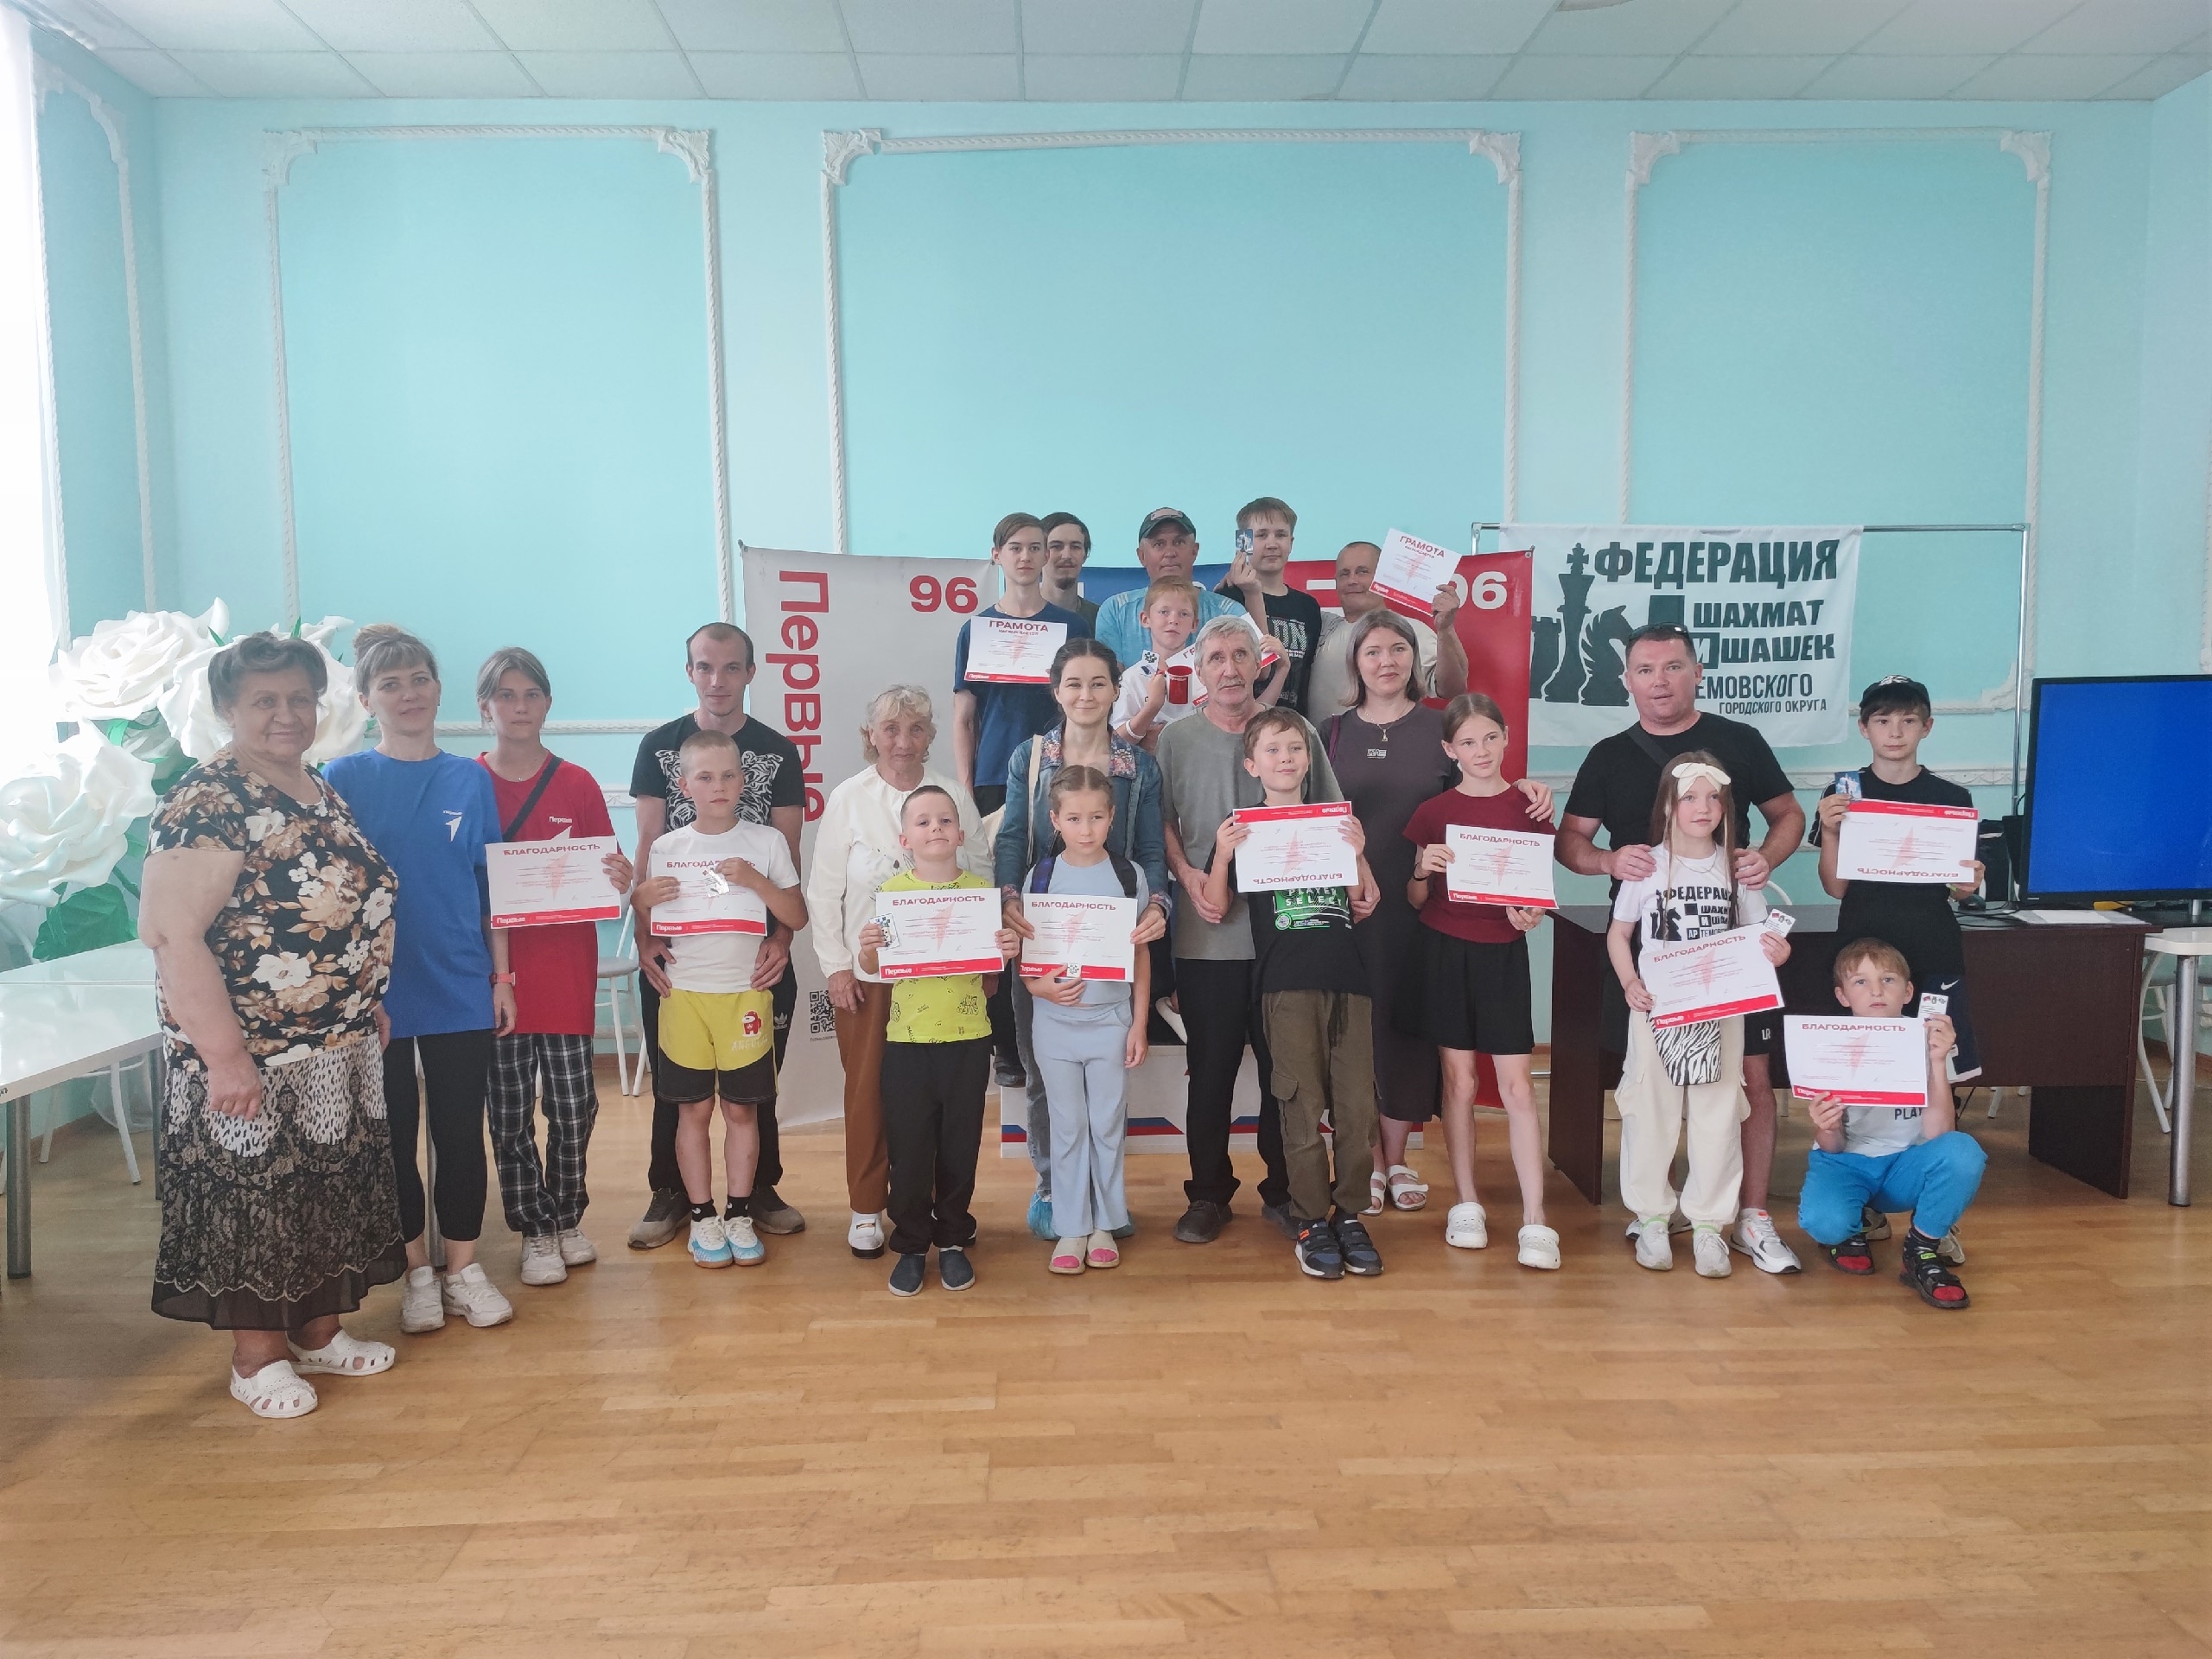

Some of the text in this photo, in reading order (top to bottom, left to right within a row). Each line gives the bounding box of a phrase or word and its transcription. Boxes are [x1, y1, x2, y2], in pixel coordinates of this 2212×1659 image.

[1399, 535, 1446, 558] ГРАМОТА
[1594, 539, 1840, 589] ФЕДЕРАЦИЯ
[909, 575, 979, 613] 96
[1693, 599, 1825, 628] ШАХМАТ
[988, 620, 1049, 632] ГРАМОТА
[1720, 633, 1836, 664] ШАШЕК
[1694, 673, 1813, 700] ЕМОВСКОГО
[1719, 698, 1827, 715] ГОРОДСКОГО ОКРУГА
[1459, 833, 1541, 847] БЛАГОДАРНОСТЬ
[503, 843, 601, 855] БЛАГОДАРНОСТЬ
[666, 860, 756, 868] БЛАГОДАЬ
[1253, 873, 1343, 885] БЛАГОДАРНОСТЬ
[1857, 867, 1960, 878] БЛАГОДАРНОСТЬ
[893, 895, 986, 906] БЛАГОДАРНОСТЬ
[1285, 895, 1342, 906] SELECT
[1662, 886, 1728, 901] ФЕДЕРАЦ
[1031, 901, 1116, 911] БЛАГОДАРНОСТЬ
[1653, 935, 1746, 963] БЛАГОДАРНОСТЬ
[1802, 1023, 1906, 1032] БЛАГОДАРНОСТЬ
